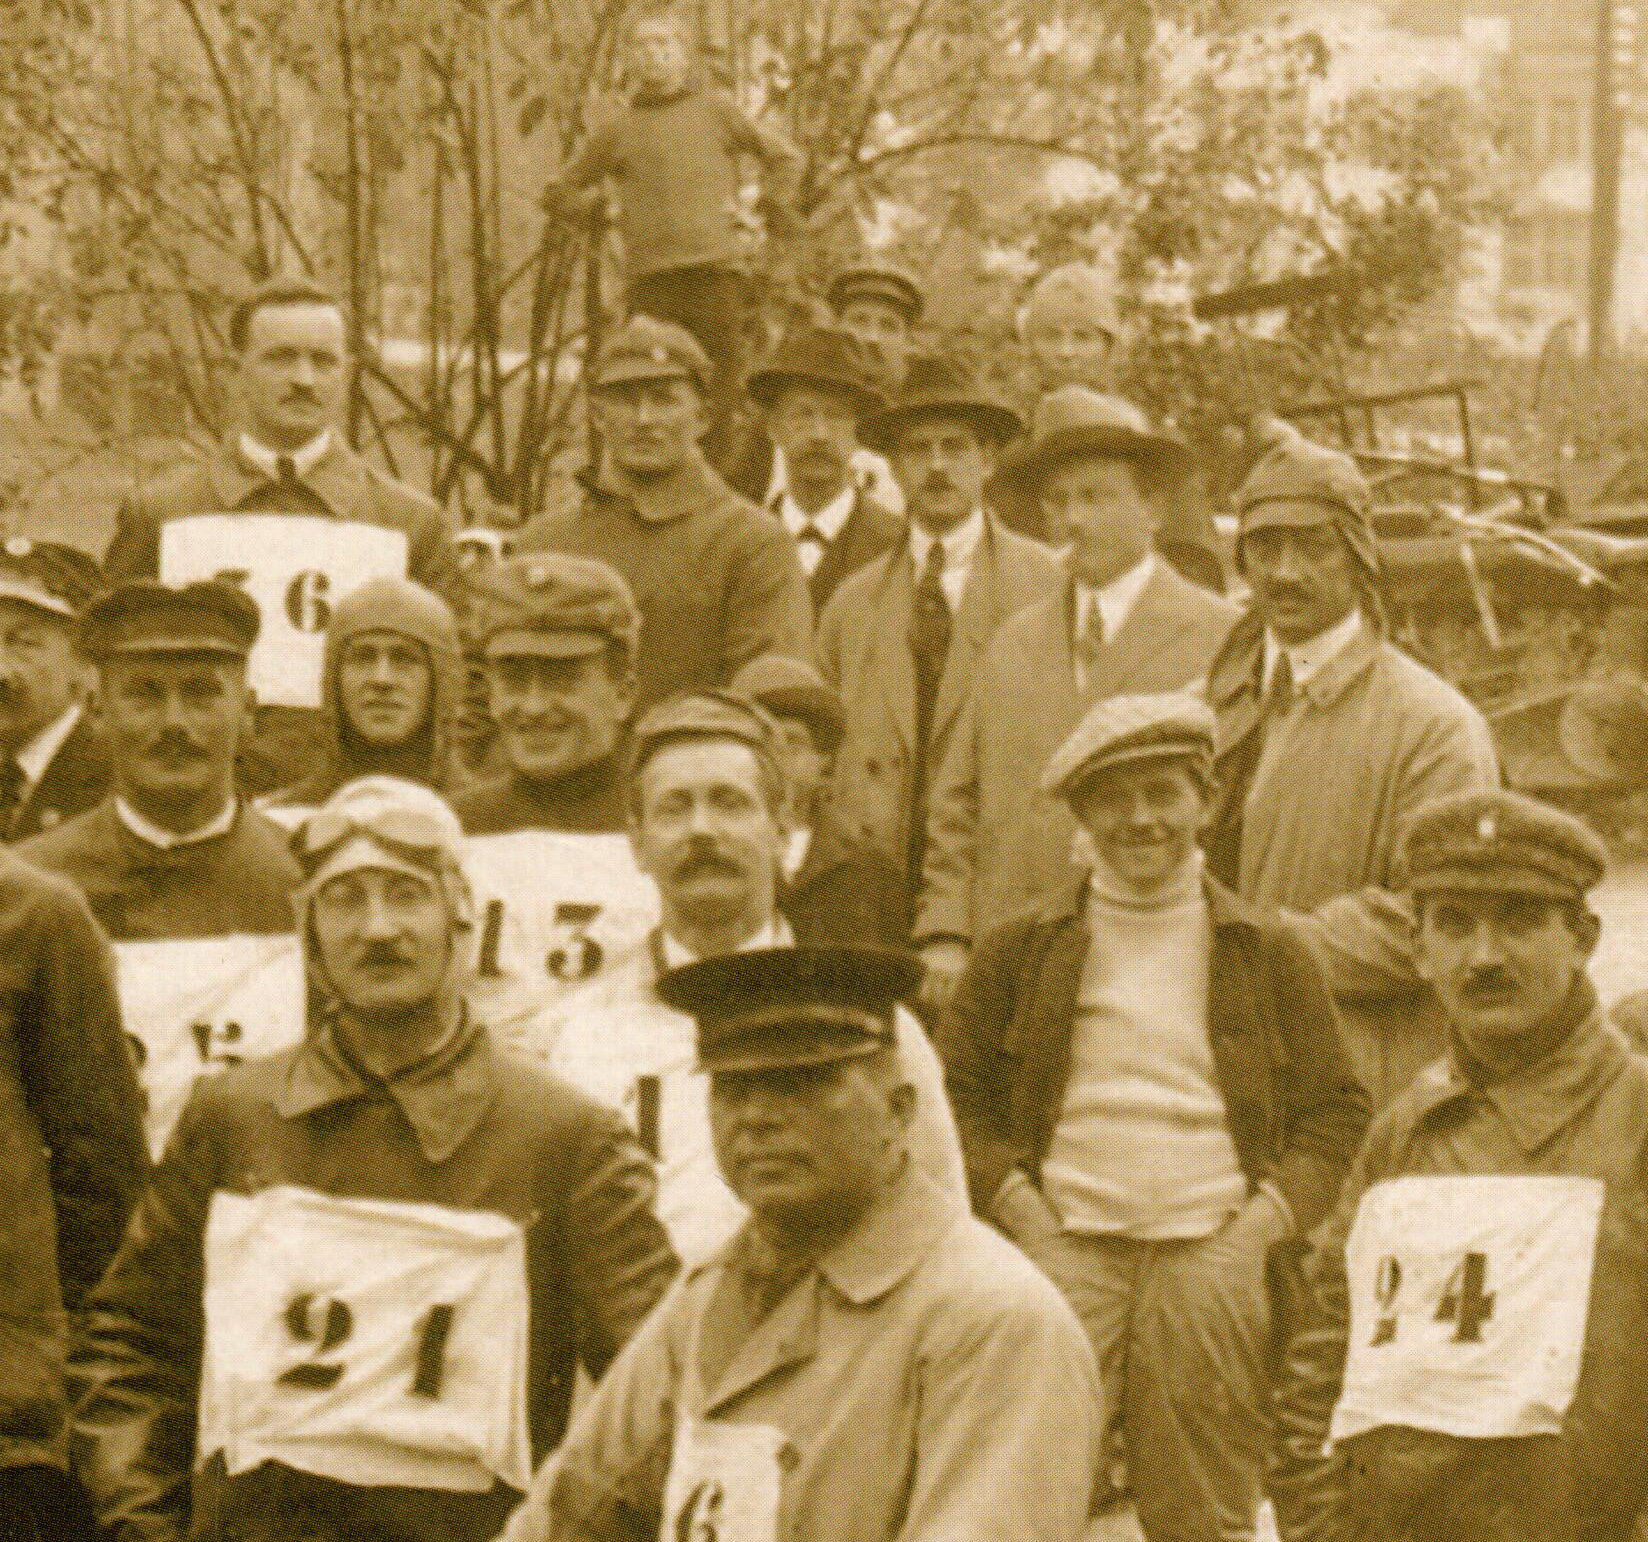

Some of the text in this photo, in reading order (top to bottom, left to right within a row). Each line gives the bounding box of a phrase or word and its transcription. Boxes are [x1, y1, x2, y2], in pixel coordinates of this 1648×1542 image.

[477, 897, 605, 982] 13
[274, 1292, 458, 1402] 21
[1368, 1251, 1497, 1349] 24
